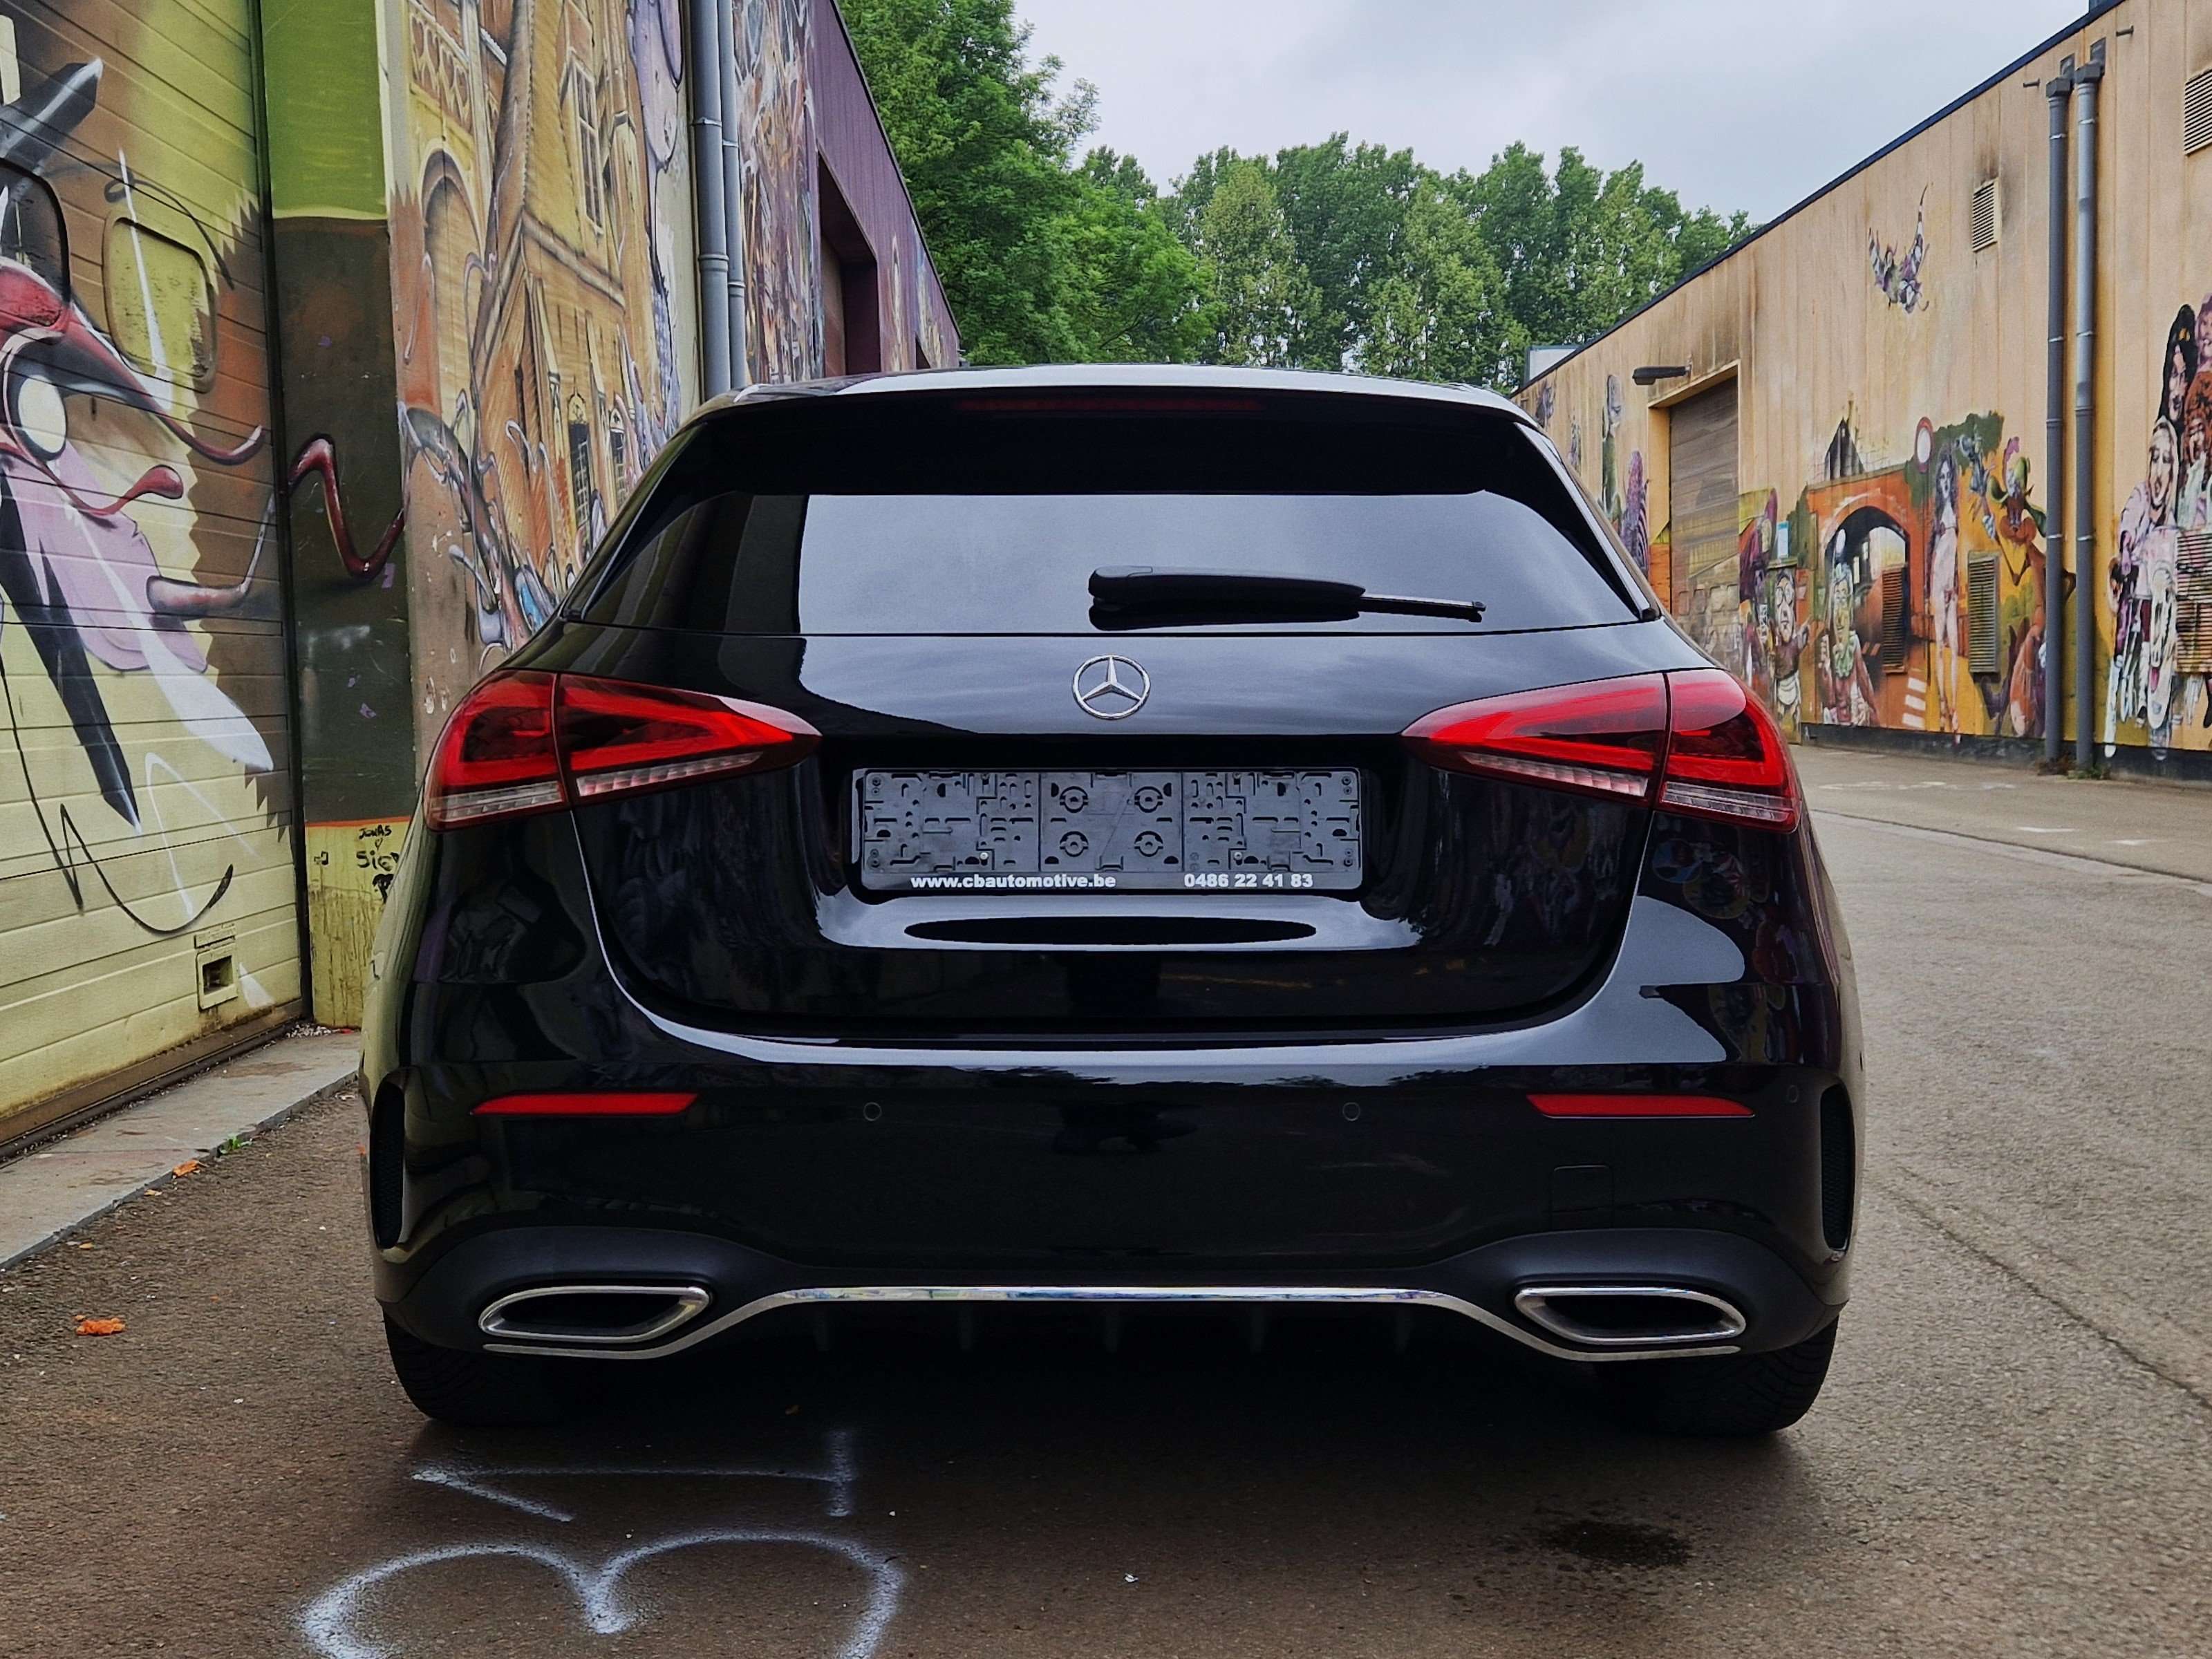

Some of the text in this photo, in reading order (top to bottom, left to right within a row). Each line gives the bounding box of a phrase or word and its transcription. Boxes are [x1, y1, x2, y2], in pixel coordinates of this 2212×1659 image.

[910, 873, 1116, 888] www.cbautomotive.be
[1184, 873, 1313, 888] 0486 22 41 83
